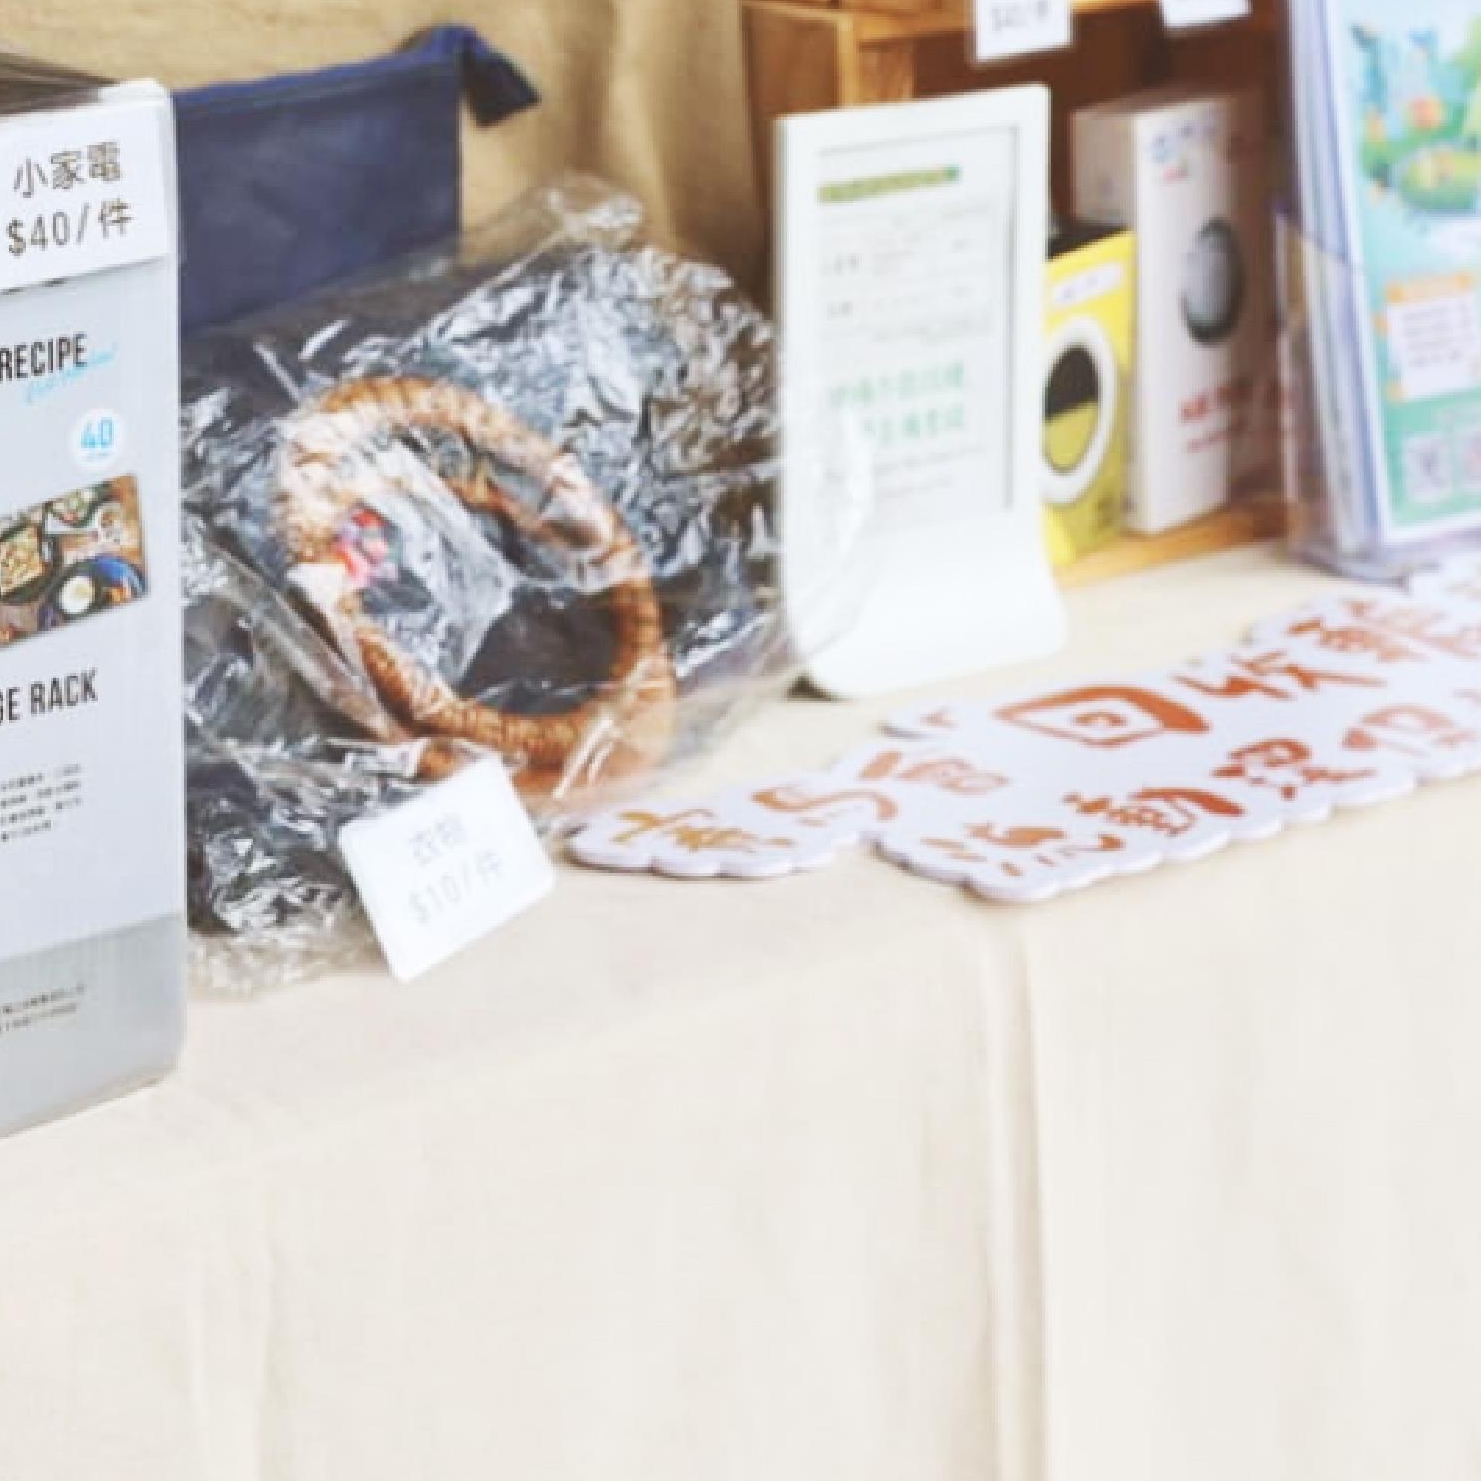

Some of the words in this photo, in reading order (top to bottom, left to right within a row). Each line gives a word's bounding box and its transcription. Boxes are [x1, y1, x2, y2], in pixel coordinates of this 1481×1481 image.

[12, 141, 123, 199] 小家電
[6, 198, 134, 257] $40/件
[29, 666, 99, 715] RACK
